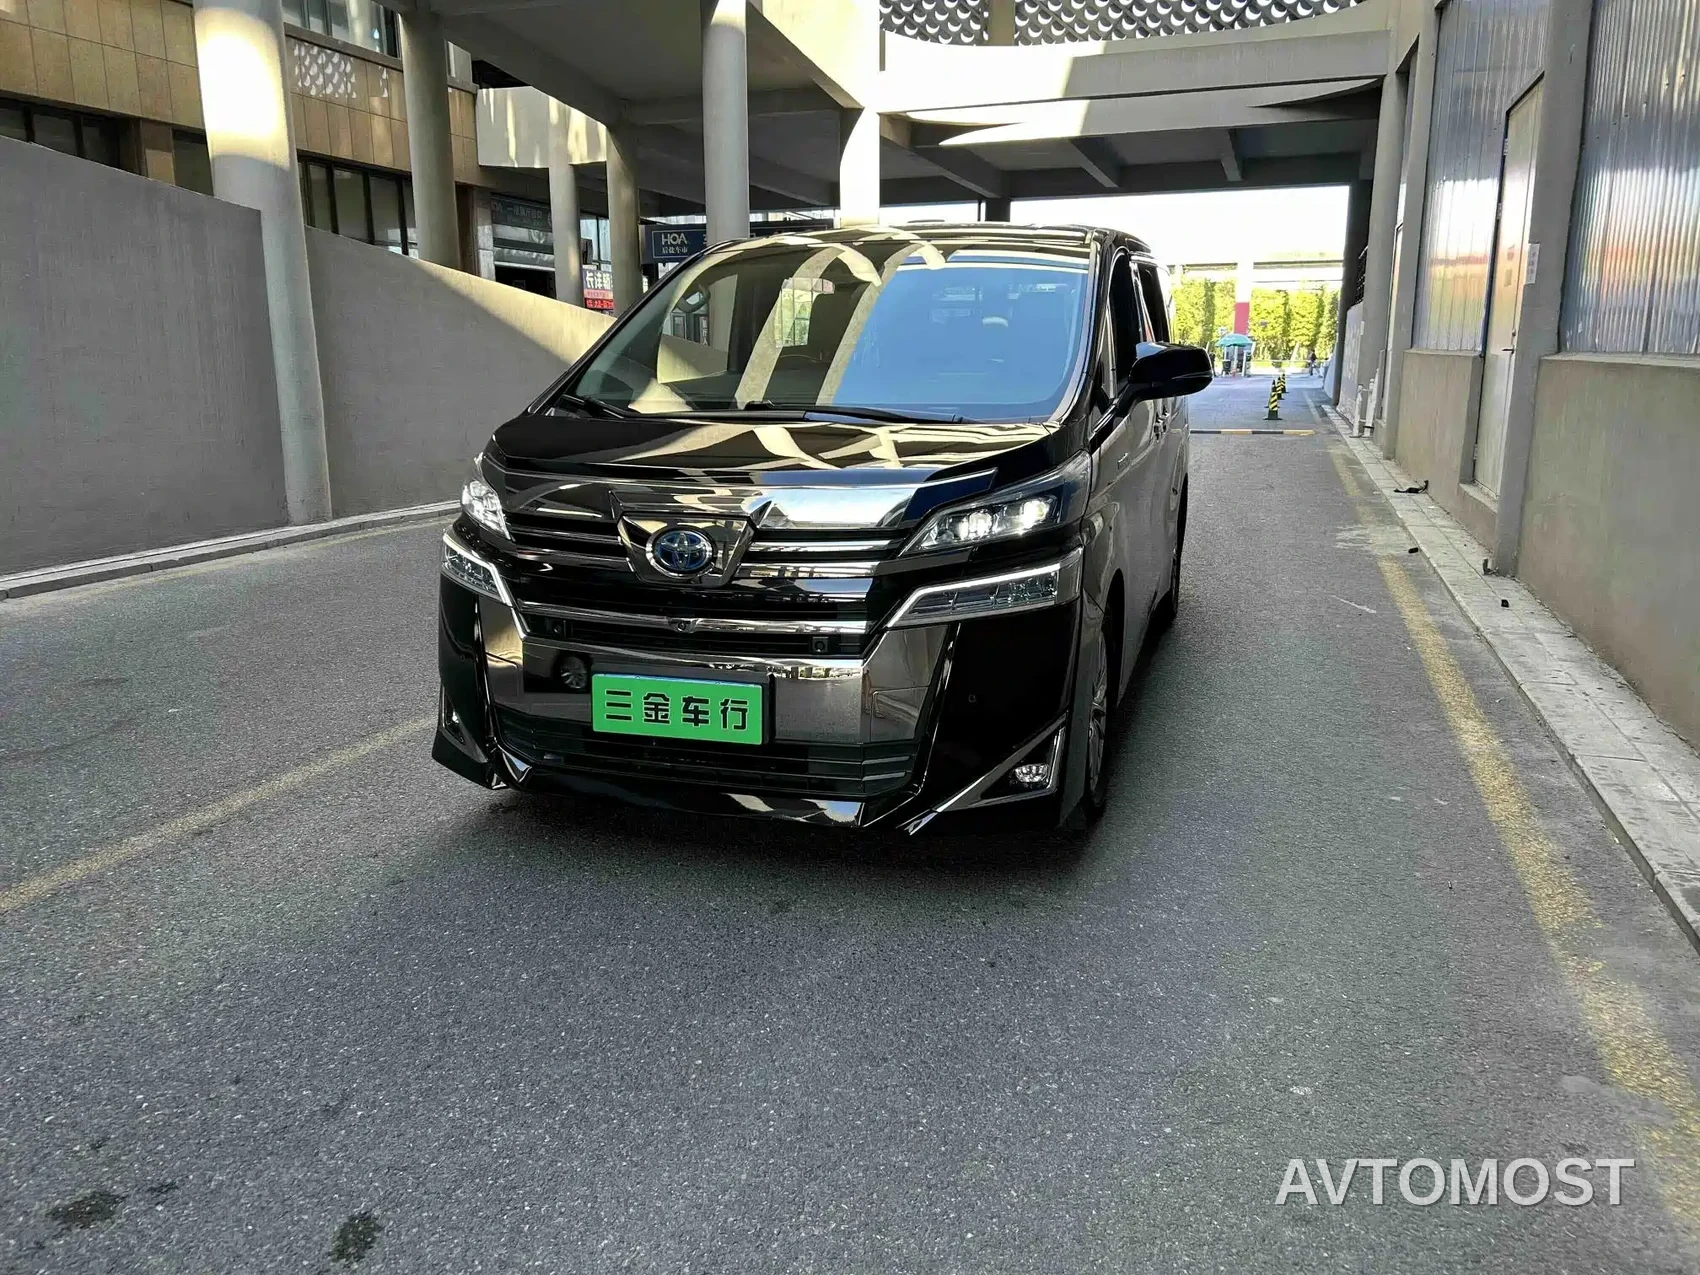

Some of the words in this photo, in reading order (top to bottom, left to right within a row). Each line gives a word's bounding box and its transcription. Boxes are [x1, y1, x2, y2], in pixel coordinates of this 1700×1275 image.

[661, 233, 688, 245] HOA
[605, 689, 749, 731] 三金车行
